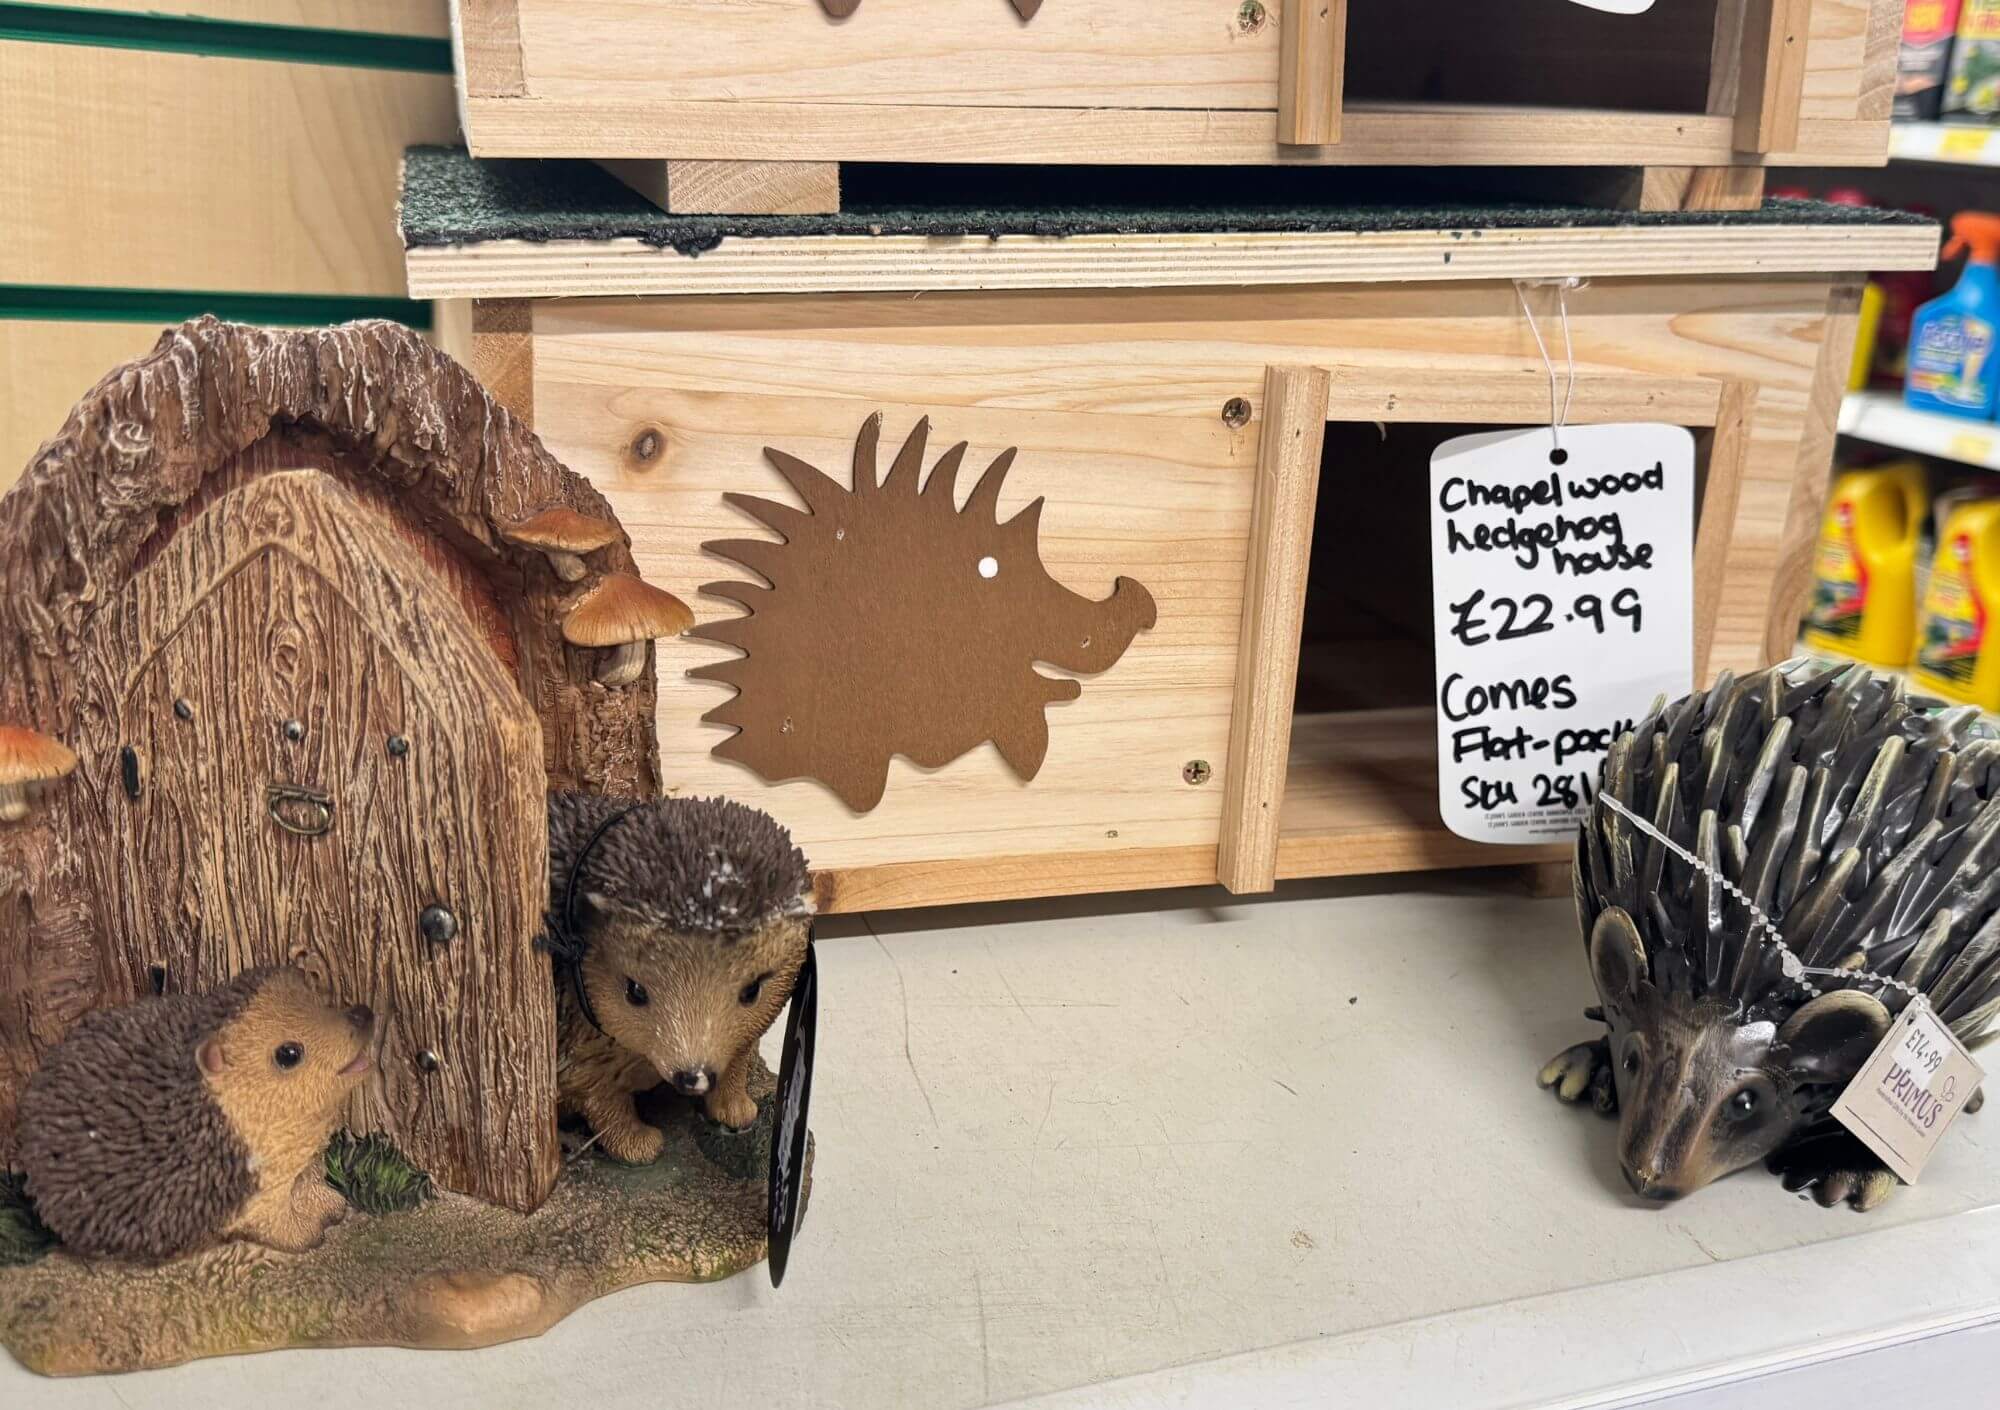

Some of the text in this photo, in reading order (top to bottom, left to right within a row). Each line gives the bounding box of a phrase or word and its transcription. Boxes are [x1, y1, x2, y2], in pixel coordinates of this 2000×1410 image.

[1447, 512, 1624, 570] hedgehog
[1552, 543, 1654, 577] house
[1449, 588, 1642, 646] £22.99
[1441, 673, 1578, 722] Comes
[1882, 1062, 1943, 1129] PRIMUS
